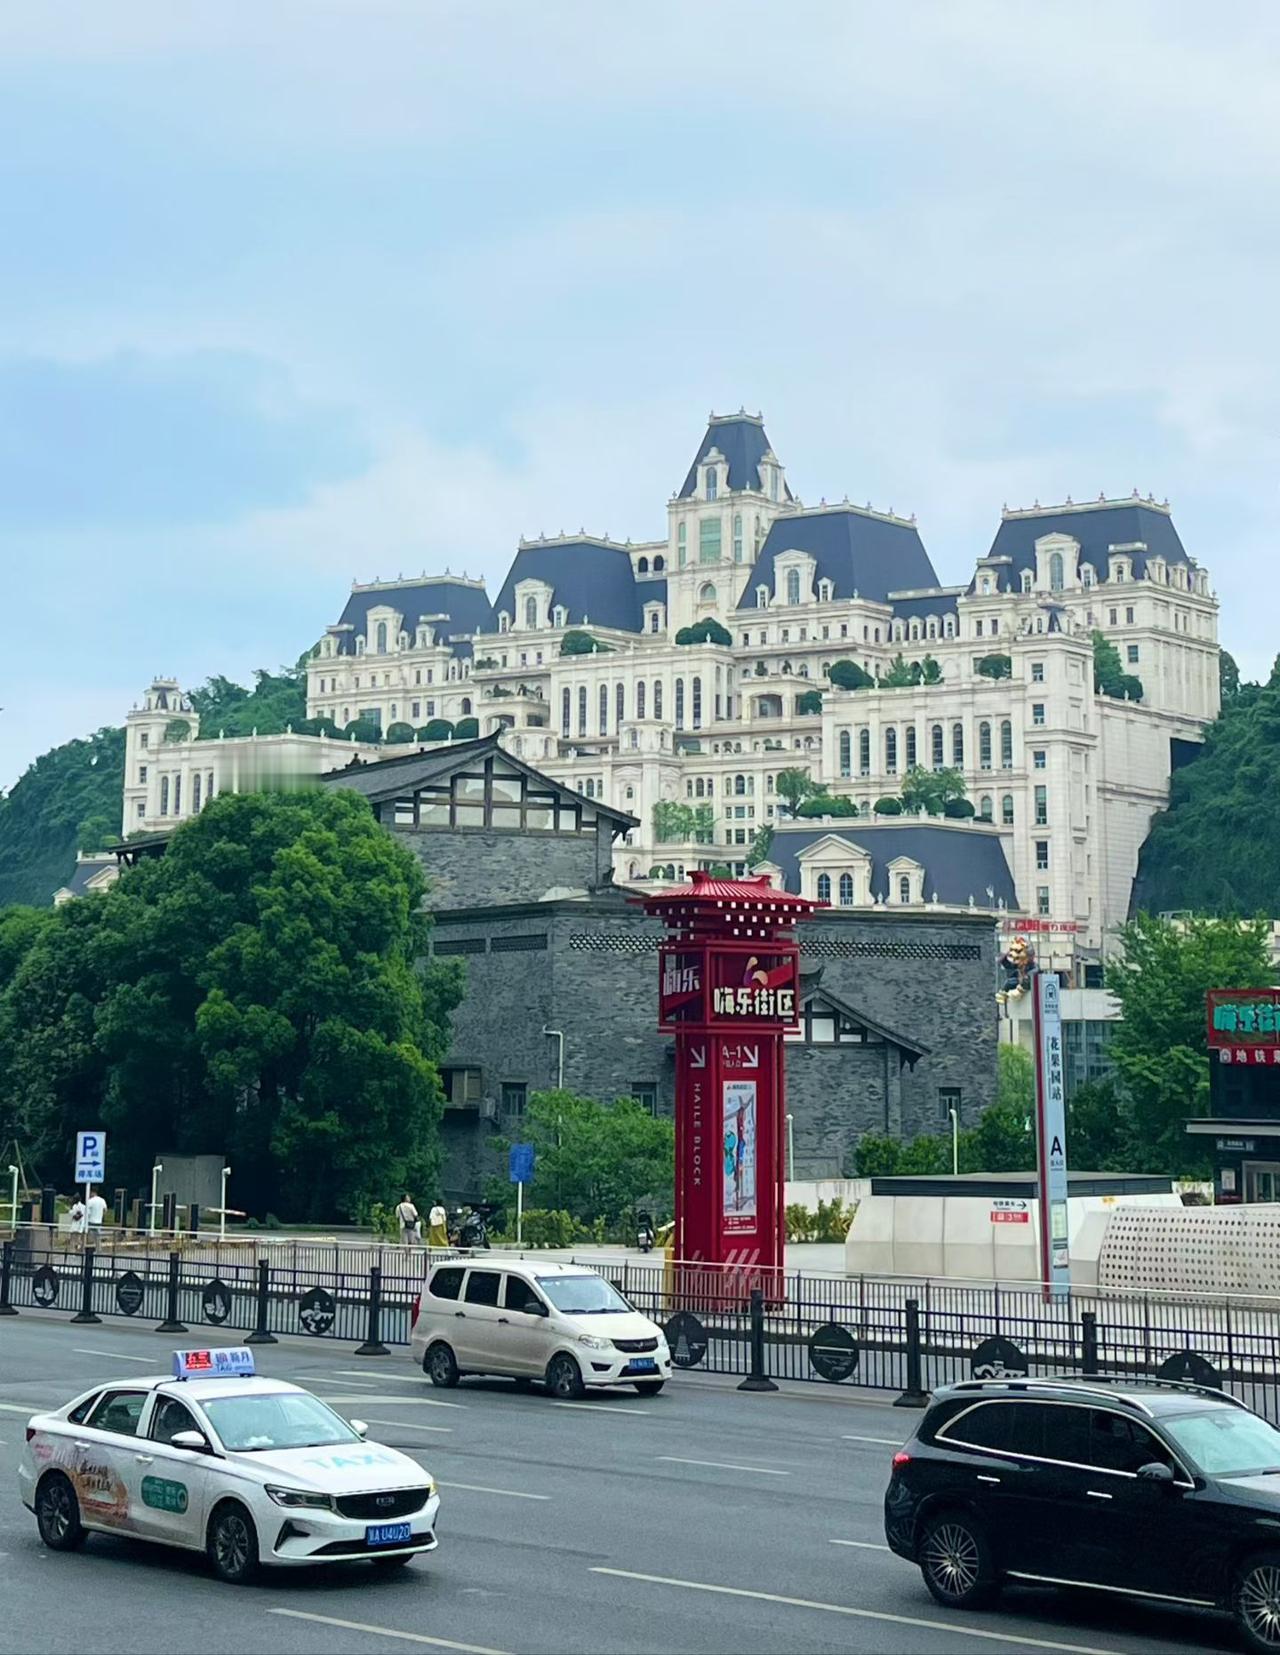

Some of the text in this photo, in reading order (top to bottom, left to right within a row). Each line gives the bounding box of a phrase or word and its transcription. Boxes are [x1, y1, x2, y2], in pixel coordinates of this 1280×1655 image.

[663, 965, 700, 996] 嗨乐
[713, 986, 795, 1016] 嗨乐街区
[722, 1045, 741, 1059] A-1
[1051, 1036, 1062, 1101] 花果园站
[82, 1136, 97, 1157] P
[693, 1083, 702, 1186] HAILE BLOCK
[1050, 1136, 1063, 1156] A
